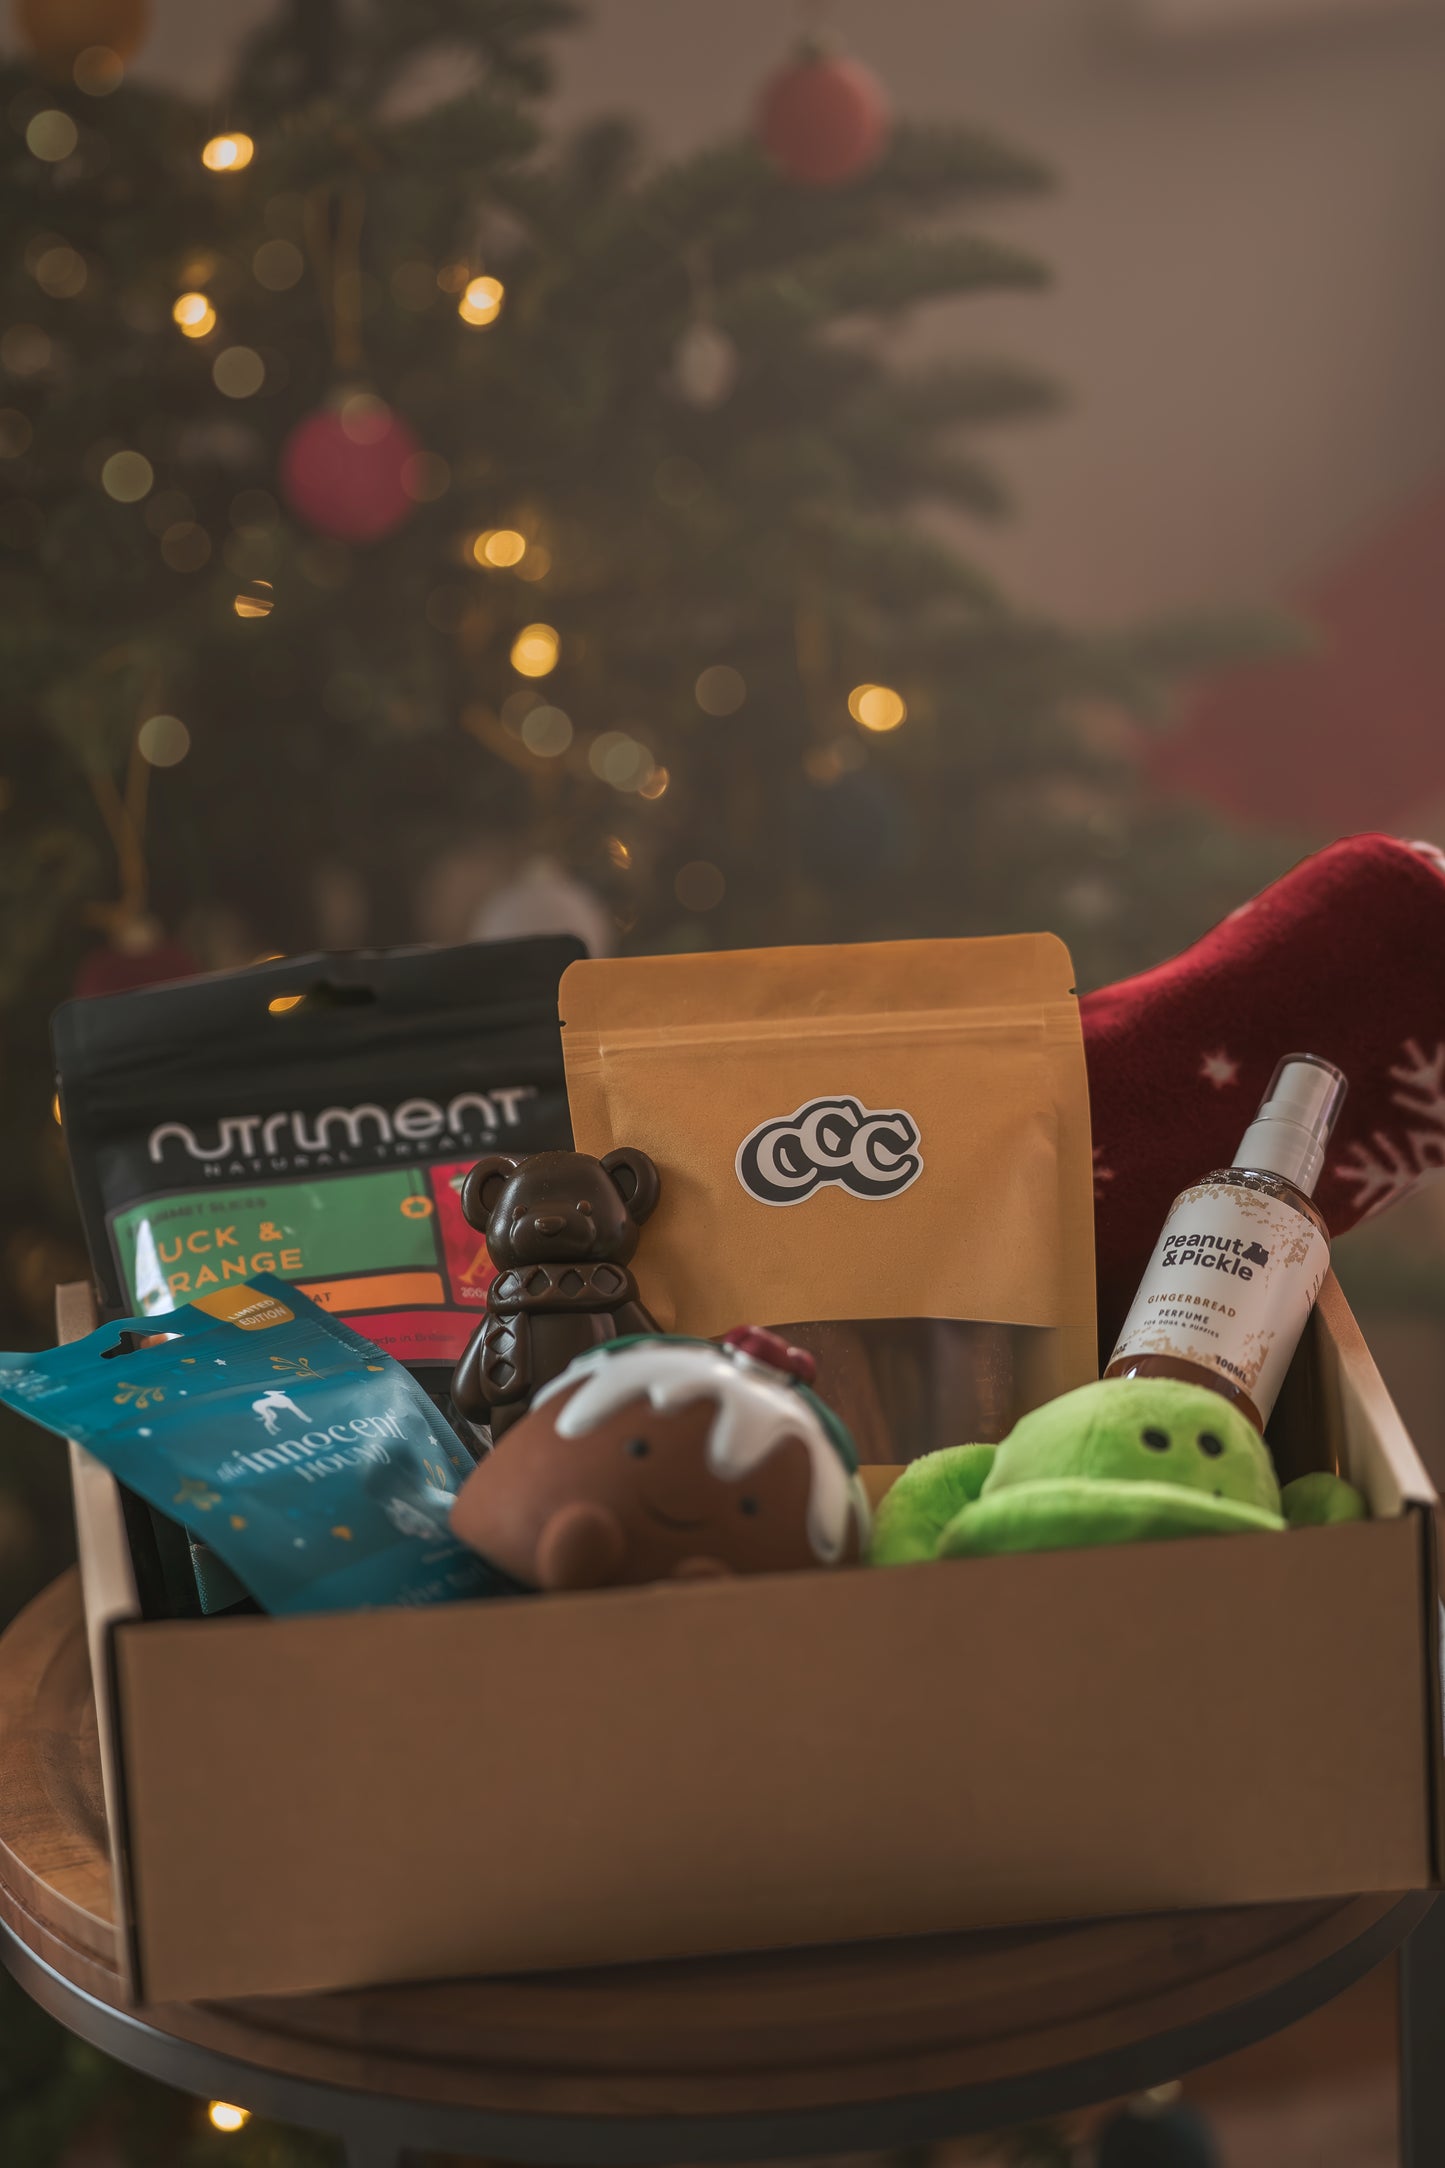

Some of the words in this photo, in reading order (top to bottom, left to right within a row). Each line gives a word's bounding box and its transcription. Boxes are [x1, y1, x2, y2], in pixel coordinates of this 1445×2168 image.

[204, 1150, 351, 1177] NATURAL
[377, 1131, 499, 1158] TREATS
[158, 1225, 239, 1263] UCK
[258, 1221, 283, 1241] &
[1163, 1233, 1244, 1256] Peanut
[166, 1248, 304, 1298] RANGE
[226, 1299, 274, 1321] LIMITED
[238, 1307, 288, 1327] EDITION
[1147, 1293, 1237, 1318] GINGERBREAD
[1158, 1309, 1210, 1325] PERFUME
[1158, 1318, 1179, 1327] DOGS
[1189, 1323, 1220, 1339] PUPPIES
[1215, 1354, 1248, 1384] 100ML
[231, 1409, 408, 1474] innocent
